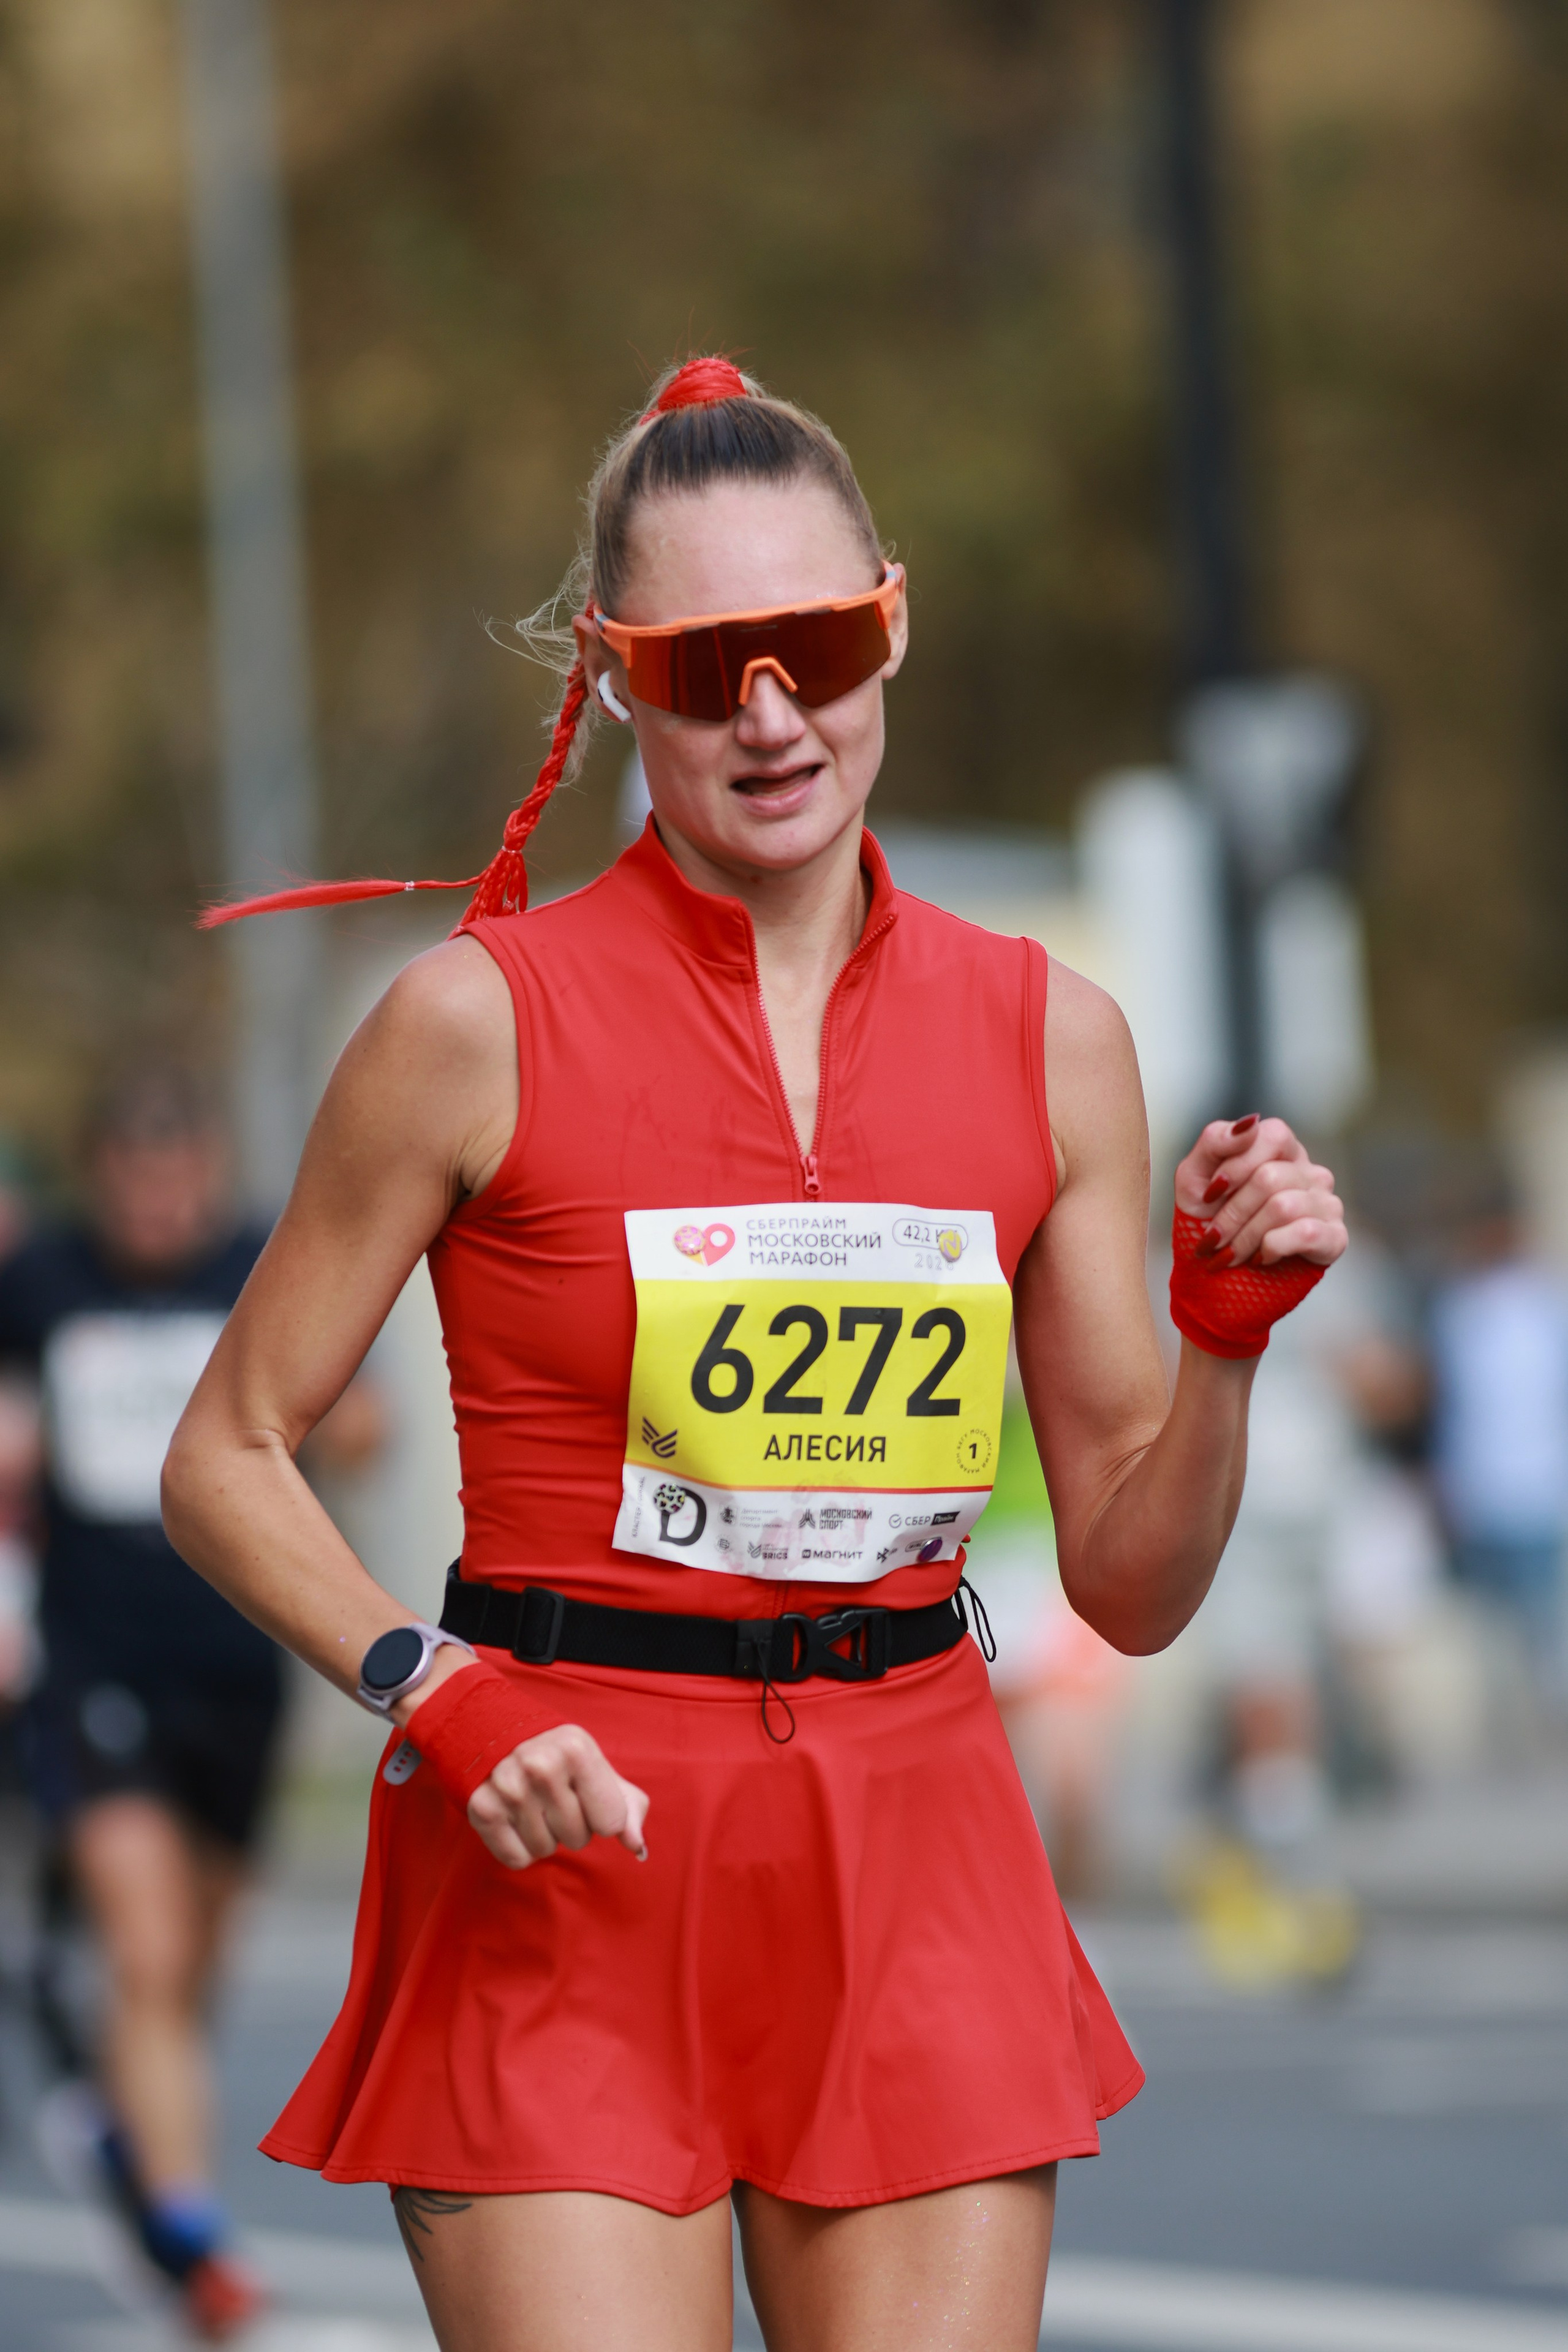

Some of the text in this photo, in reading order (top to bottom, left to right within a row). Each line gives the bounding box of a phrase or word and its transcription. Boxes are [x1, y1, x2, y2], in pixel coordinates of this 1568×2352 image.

[746, 1216, 846, 1230] СБЕРПРАЙМ
[748, 1232, 881, 1248] МОСКОВСКИЙ
[903, 1225, 930, 1242] 42,2
[750, 1251, 846, 1266] МАРАФОН
[690, 1304, 966, 1417] 6272
[763, 1434, 886, 1463] АЛЕСИЯ
[969, 1442, 977, 1459] 1
[820, 1508, 872, 1520] МОСКОВСКИЙ
[905, 1516, 931, 1526] СБЕР
[820, 1520, 843, 1529] СПОРТ
